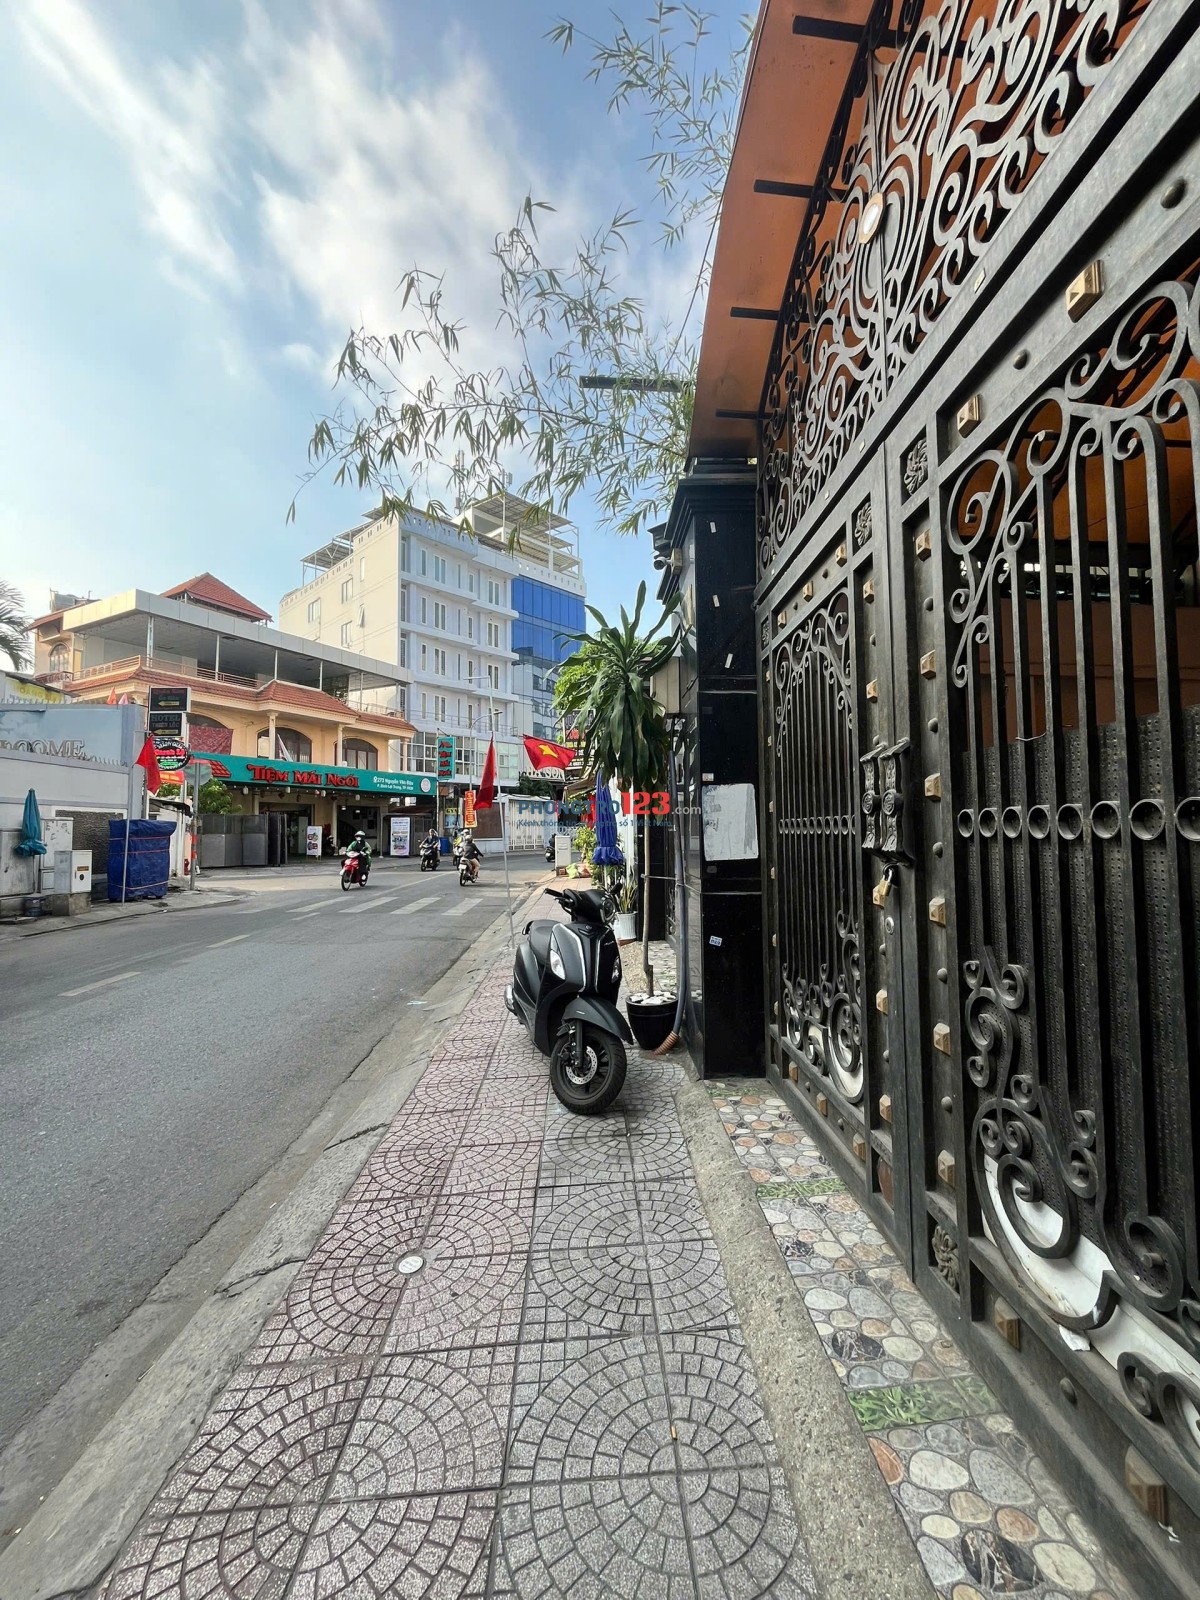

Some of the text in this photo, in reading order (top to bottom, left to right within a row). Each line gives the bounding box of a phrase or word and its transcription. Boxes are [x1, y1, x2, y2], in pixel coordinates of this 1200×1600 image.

[247, 764, 359, 788] TIỆM MÁI NGÓI
